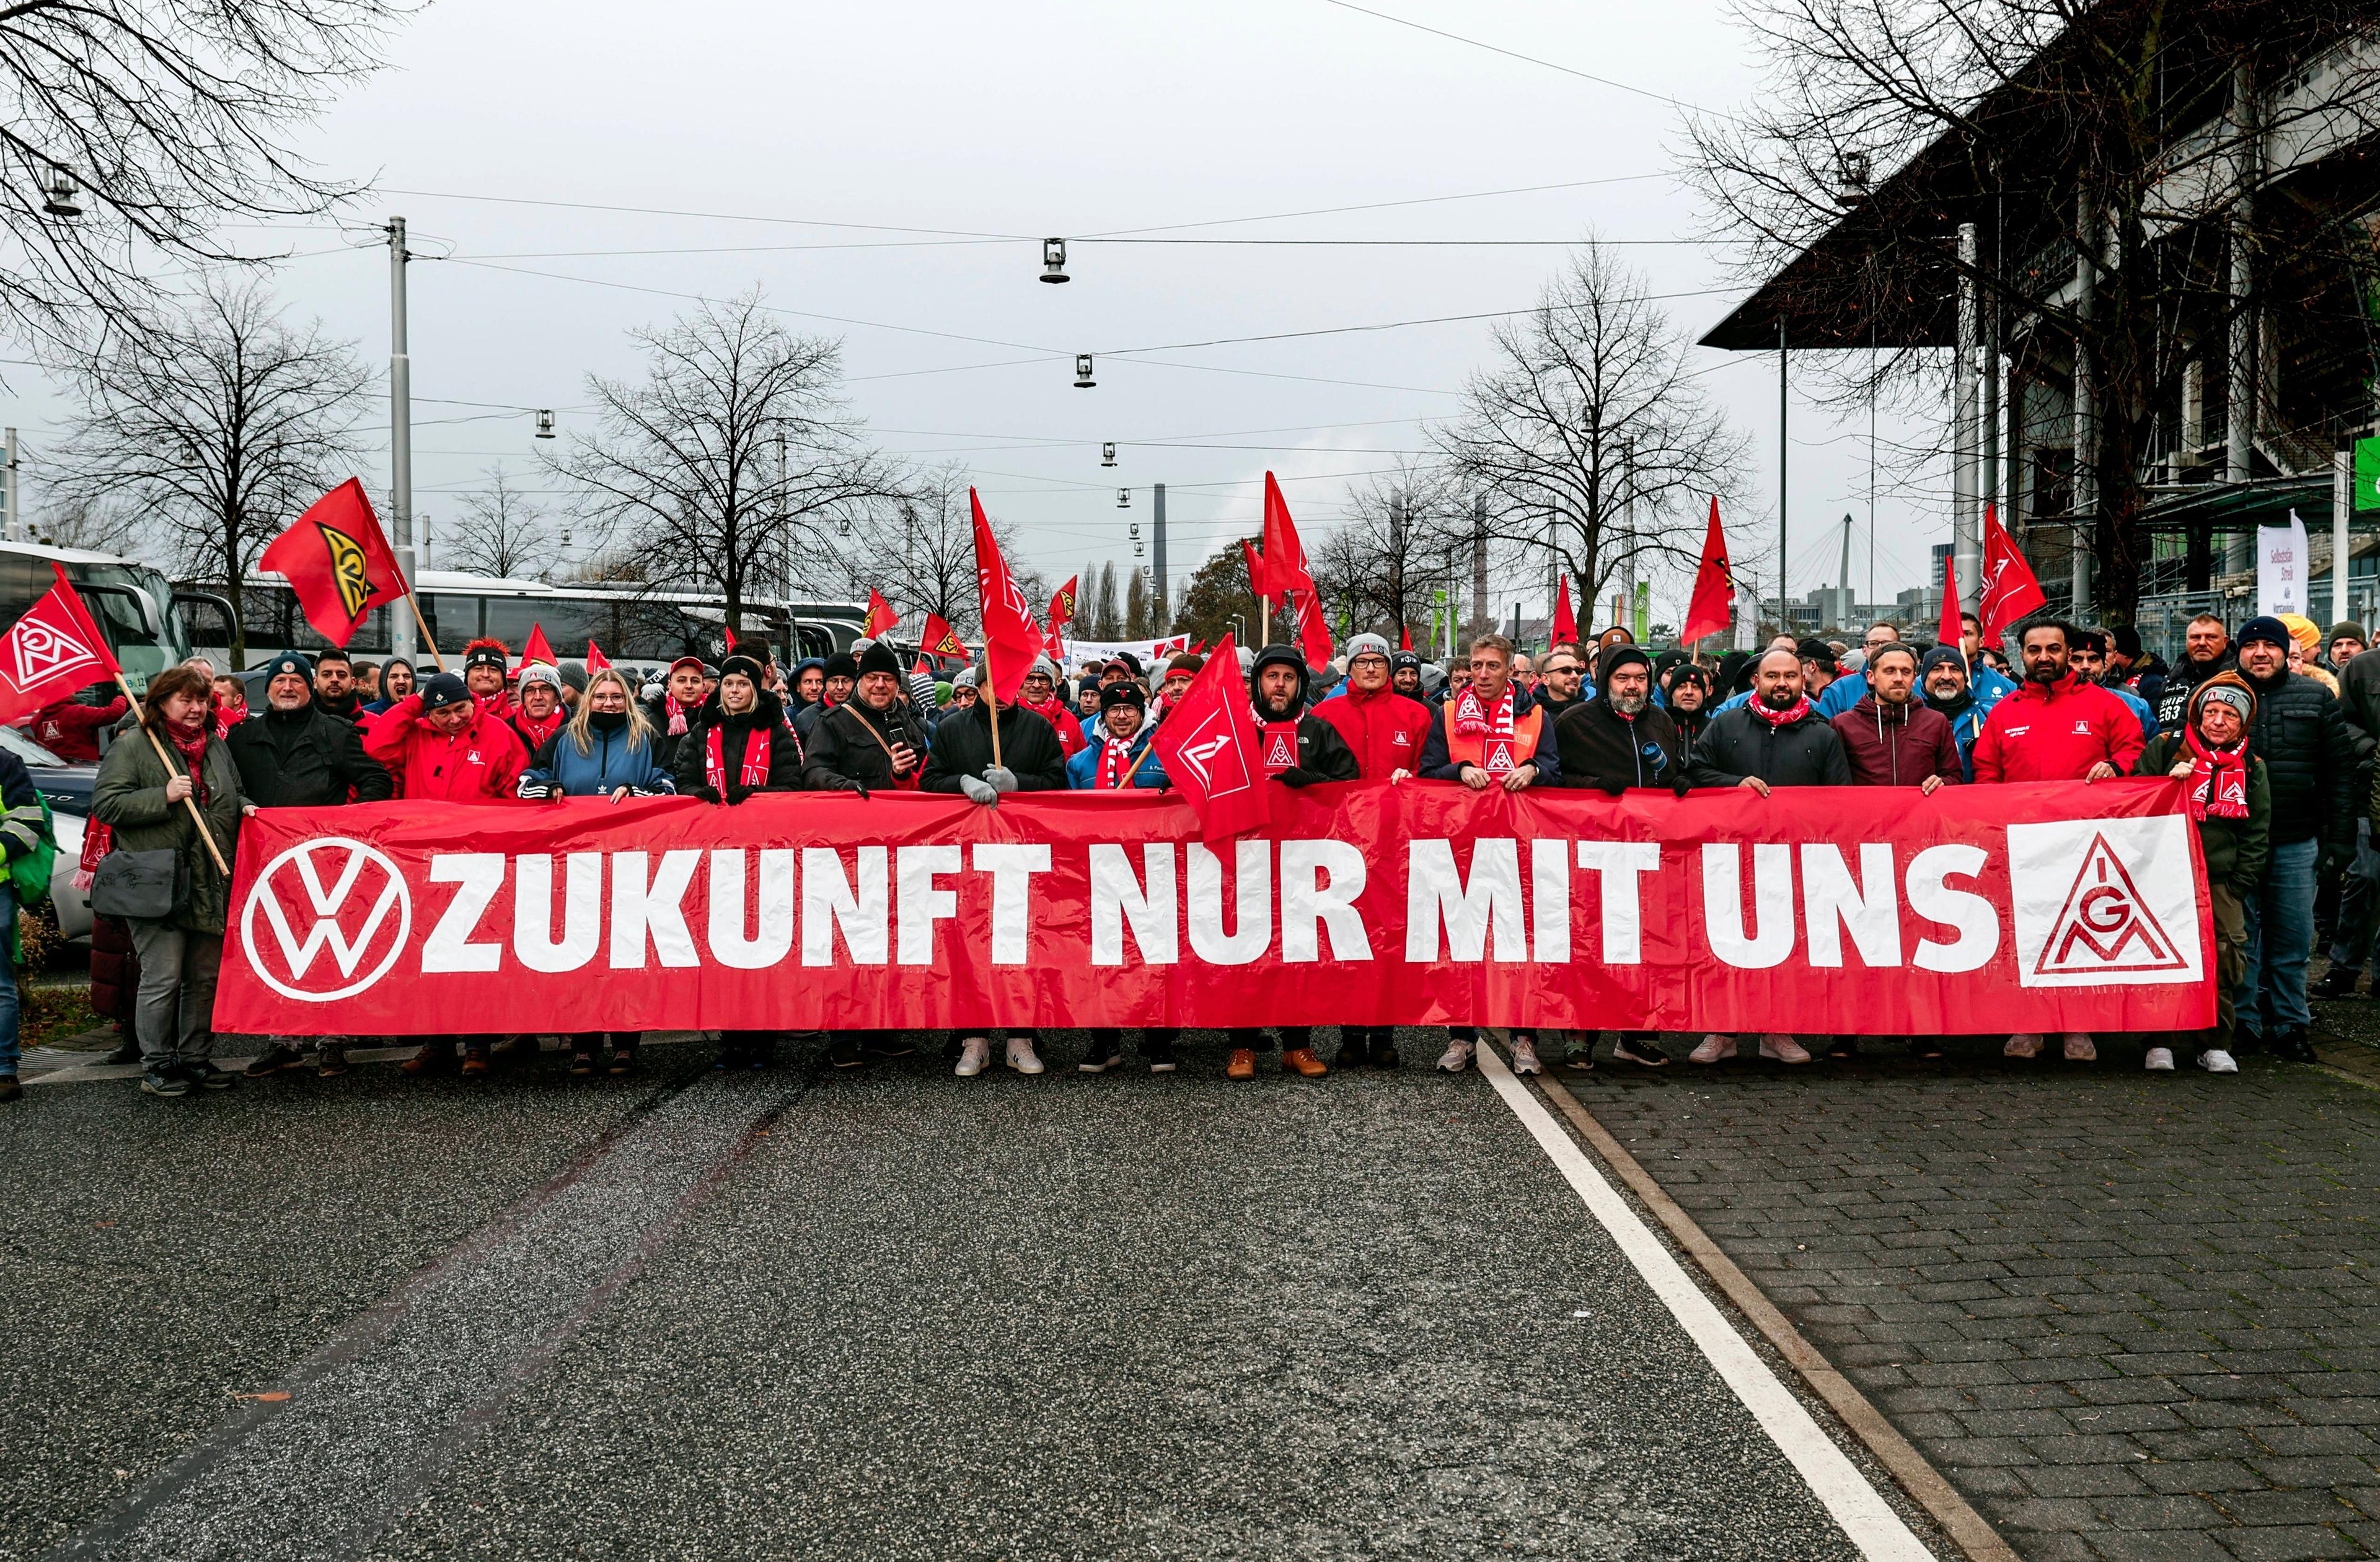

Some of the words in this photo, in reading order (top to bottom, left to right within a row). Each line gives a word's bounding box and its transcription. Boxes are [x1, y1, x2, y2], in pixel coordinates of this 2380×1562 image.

[137, 677, 145, 687] 12
[2164, 705, 2180, 721] 63
[240, 836, 412, 1002] VW
[421, 841, 1052, 973] ZUKUNFT
[1089, 839, 1373, 965] NUR
[1405, 838, 1660, 964] MIT
[1702, 843, 1999, 973] UNS
[2053, 856, 2167, 964] IGM
